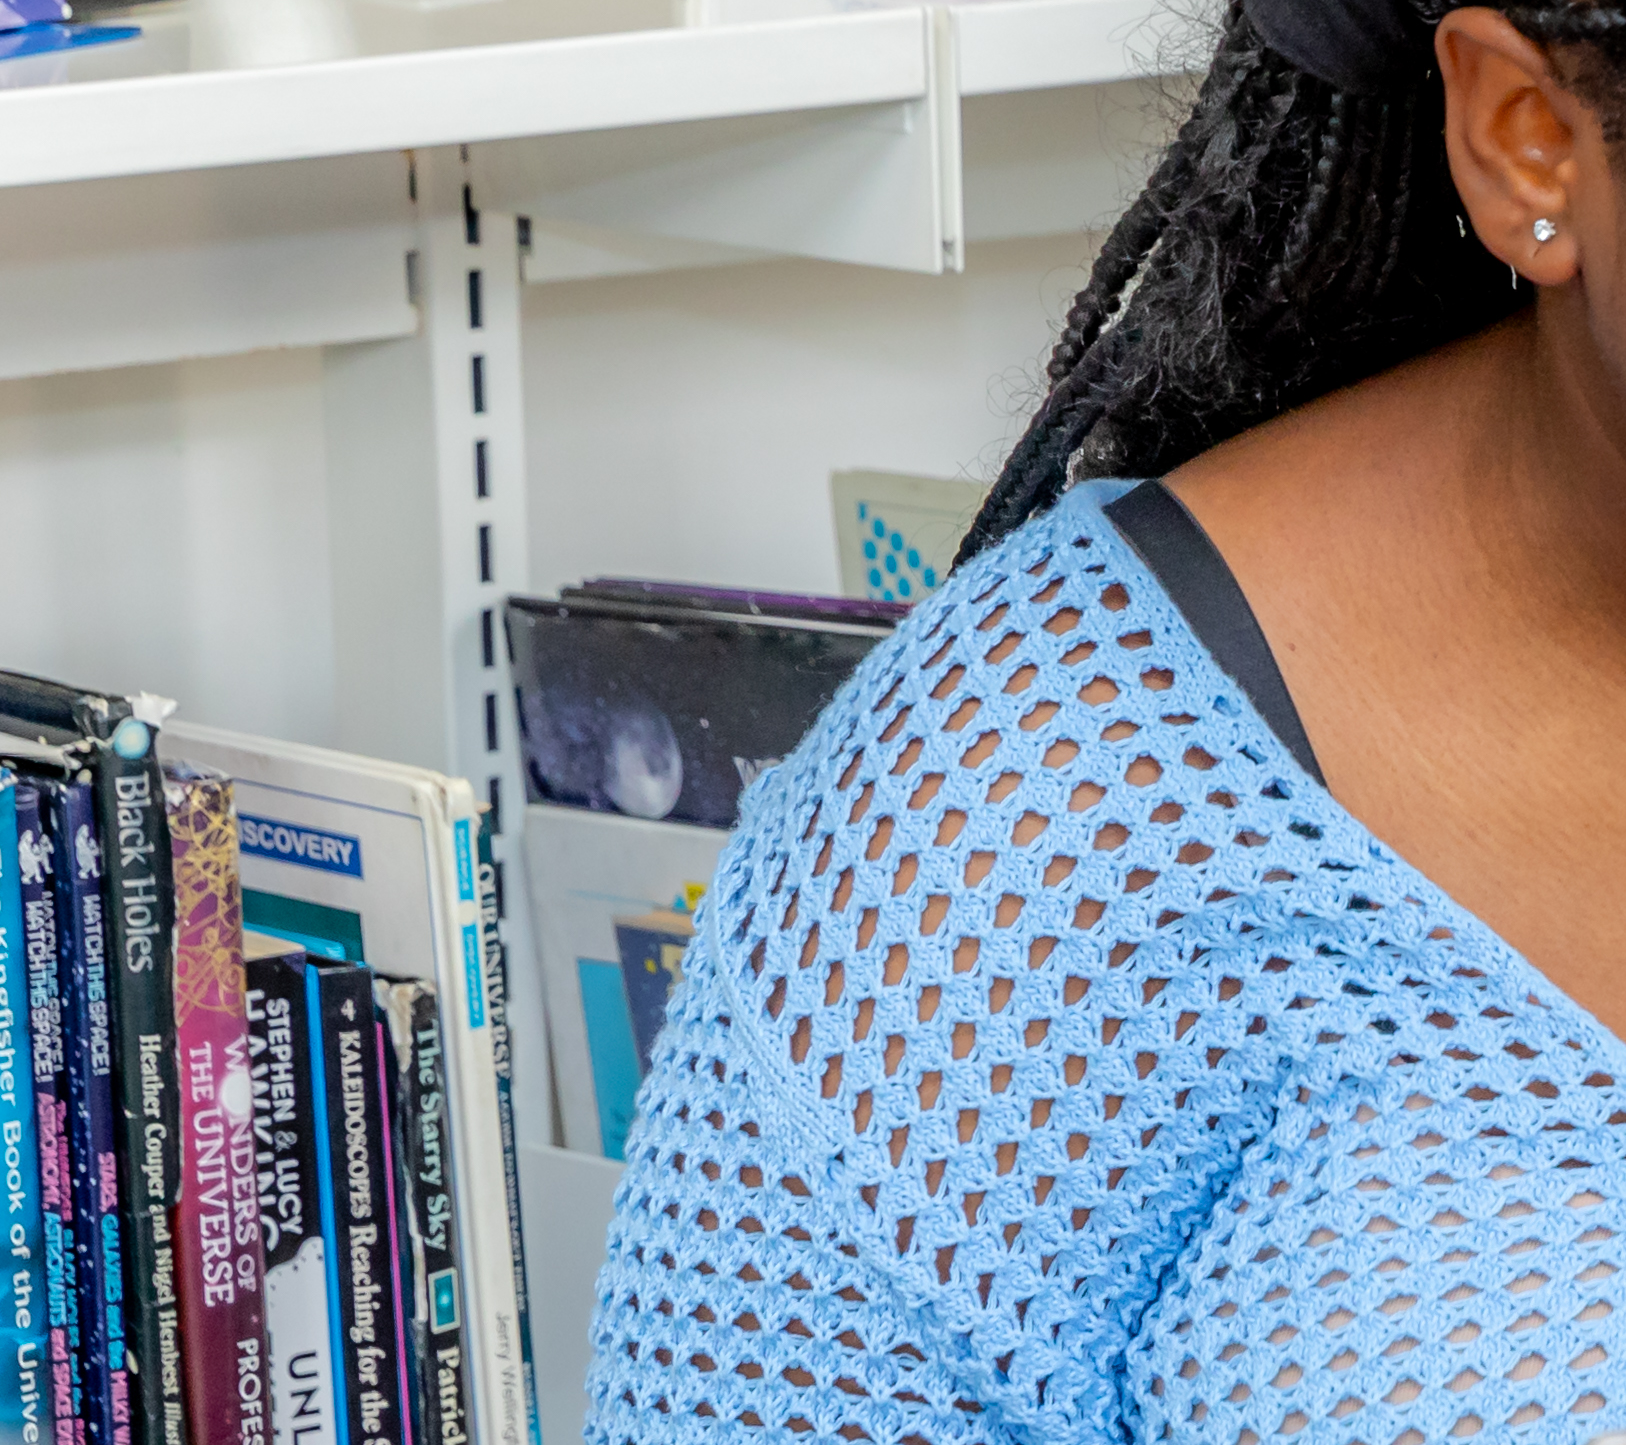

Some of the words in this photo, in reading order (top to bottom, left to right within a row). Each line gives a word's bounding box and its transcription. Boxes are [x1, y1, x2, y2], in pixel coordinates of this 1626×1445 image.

[114, 771, 156, 867] Black
[239, 818, 354, 867] ISCOVERY
[122, 876, 160, 975] Holes
[139, 1033, 162, 1117] Heather
[188, 1041, 214, 1101] THE
[266, 997, 296, 1123] STEPHEN
[415, 1019, 439, 1087] The
[223, 1032, 258, 1246] WNDERS
[273, 1130, 298, 1153] &
[338, 1030, 371, 1219] KALEIDOSCOPES
[418, 1089, 443, 1187] Starry
[3, 1120, 26, 1213] Book
[140, 1121, 167, 1201] Couper
[149, 1204, 171, 1245] and
[194, 1109, 236, 1308] UNIVERSE
[275, 1159, 304, 1236] LUCY
[424, 1193, 450, 1252] Sky
[9, 1222, 32, 1259] of
[152, 1247, 177, 1305] Nigel
[236, 1251, 257, 1292] OF
[12, 1270, 34, 1330] the
[349, 1224, 382, 1344] Reaching
[159, 1309, 181, 1396] Henbest
[356, 1344, 387, 1388] for
[495, 1312, 515, 1361] Jerry
[360, 1391, 390, 1434] the
